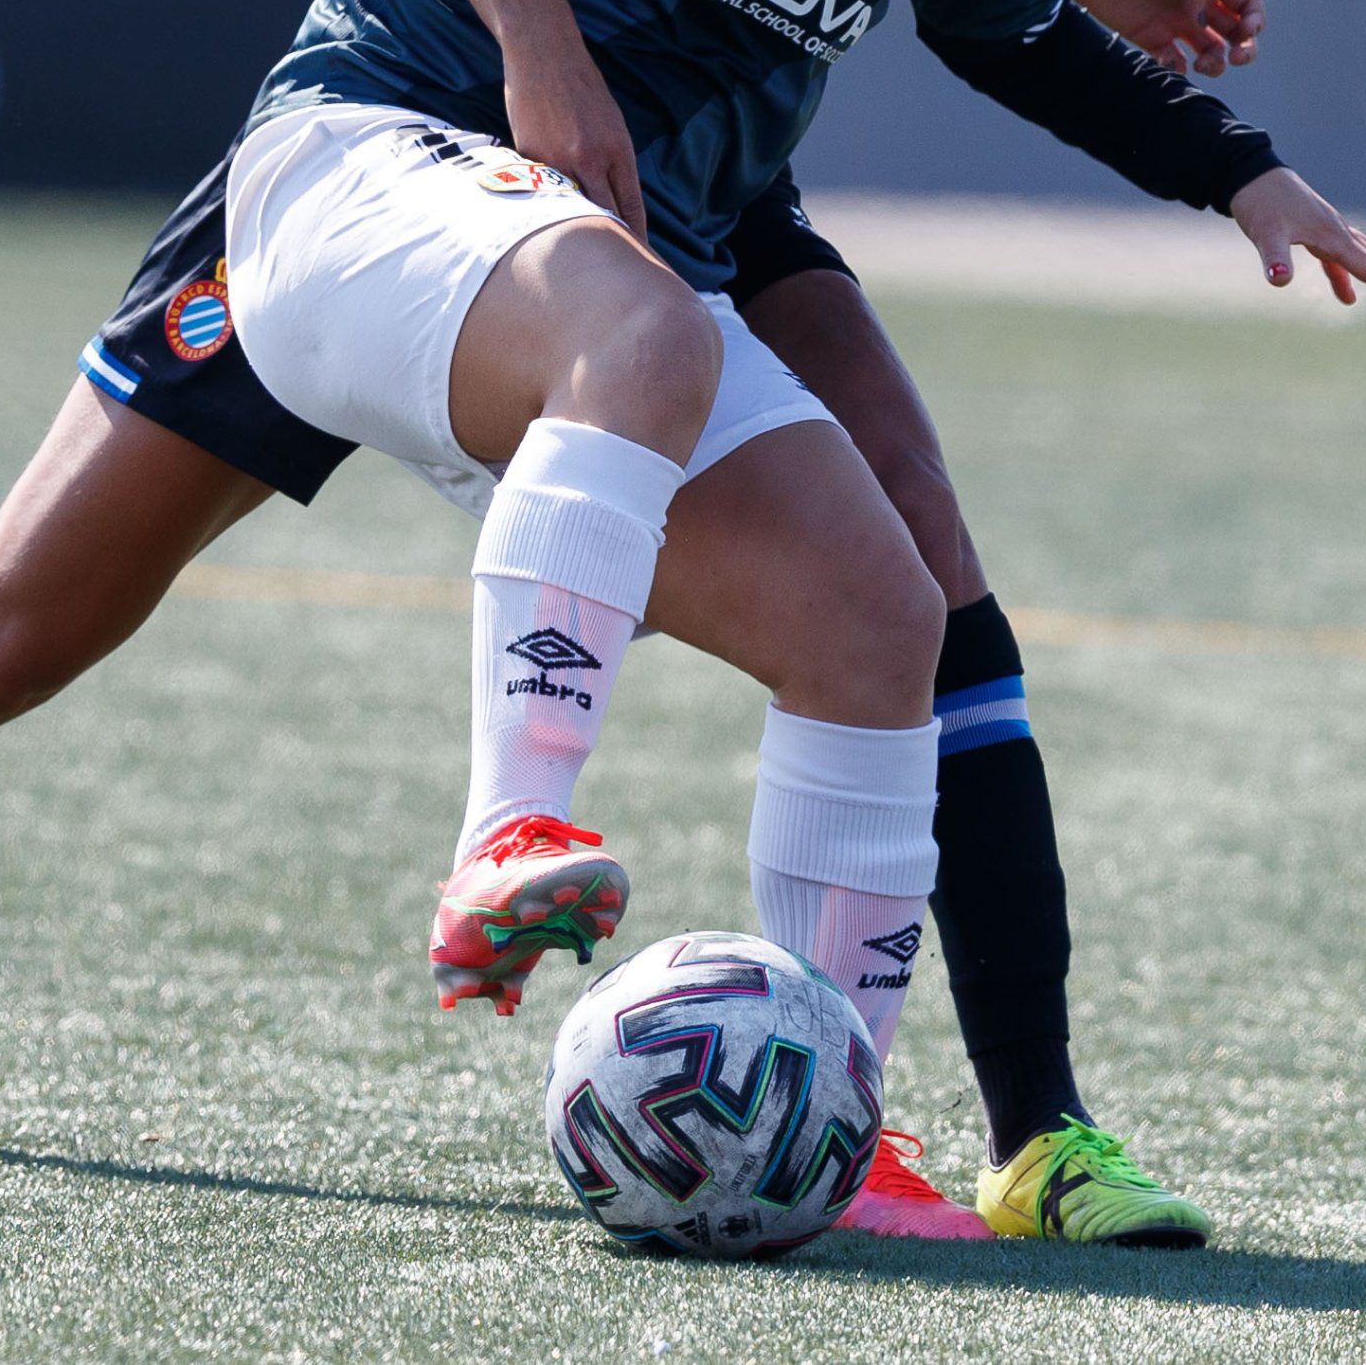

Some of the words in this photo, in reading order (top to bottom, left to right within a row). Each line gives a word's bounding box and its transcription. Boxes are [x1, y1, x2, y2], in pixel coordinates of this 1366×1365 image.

[743, 2, 806, 45] SCHOOL
[804, 36, 828, 56] OF
[505, 671, 593, 711] umbro
